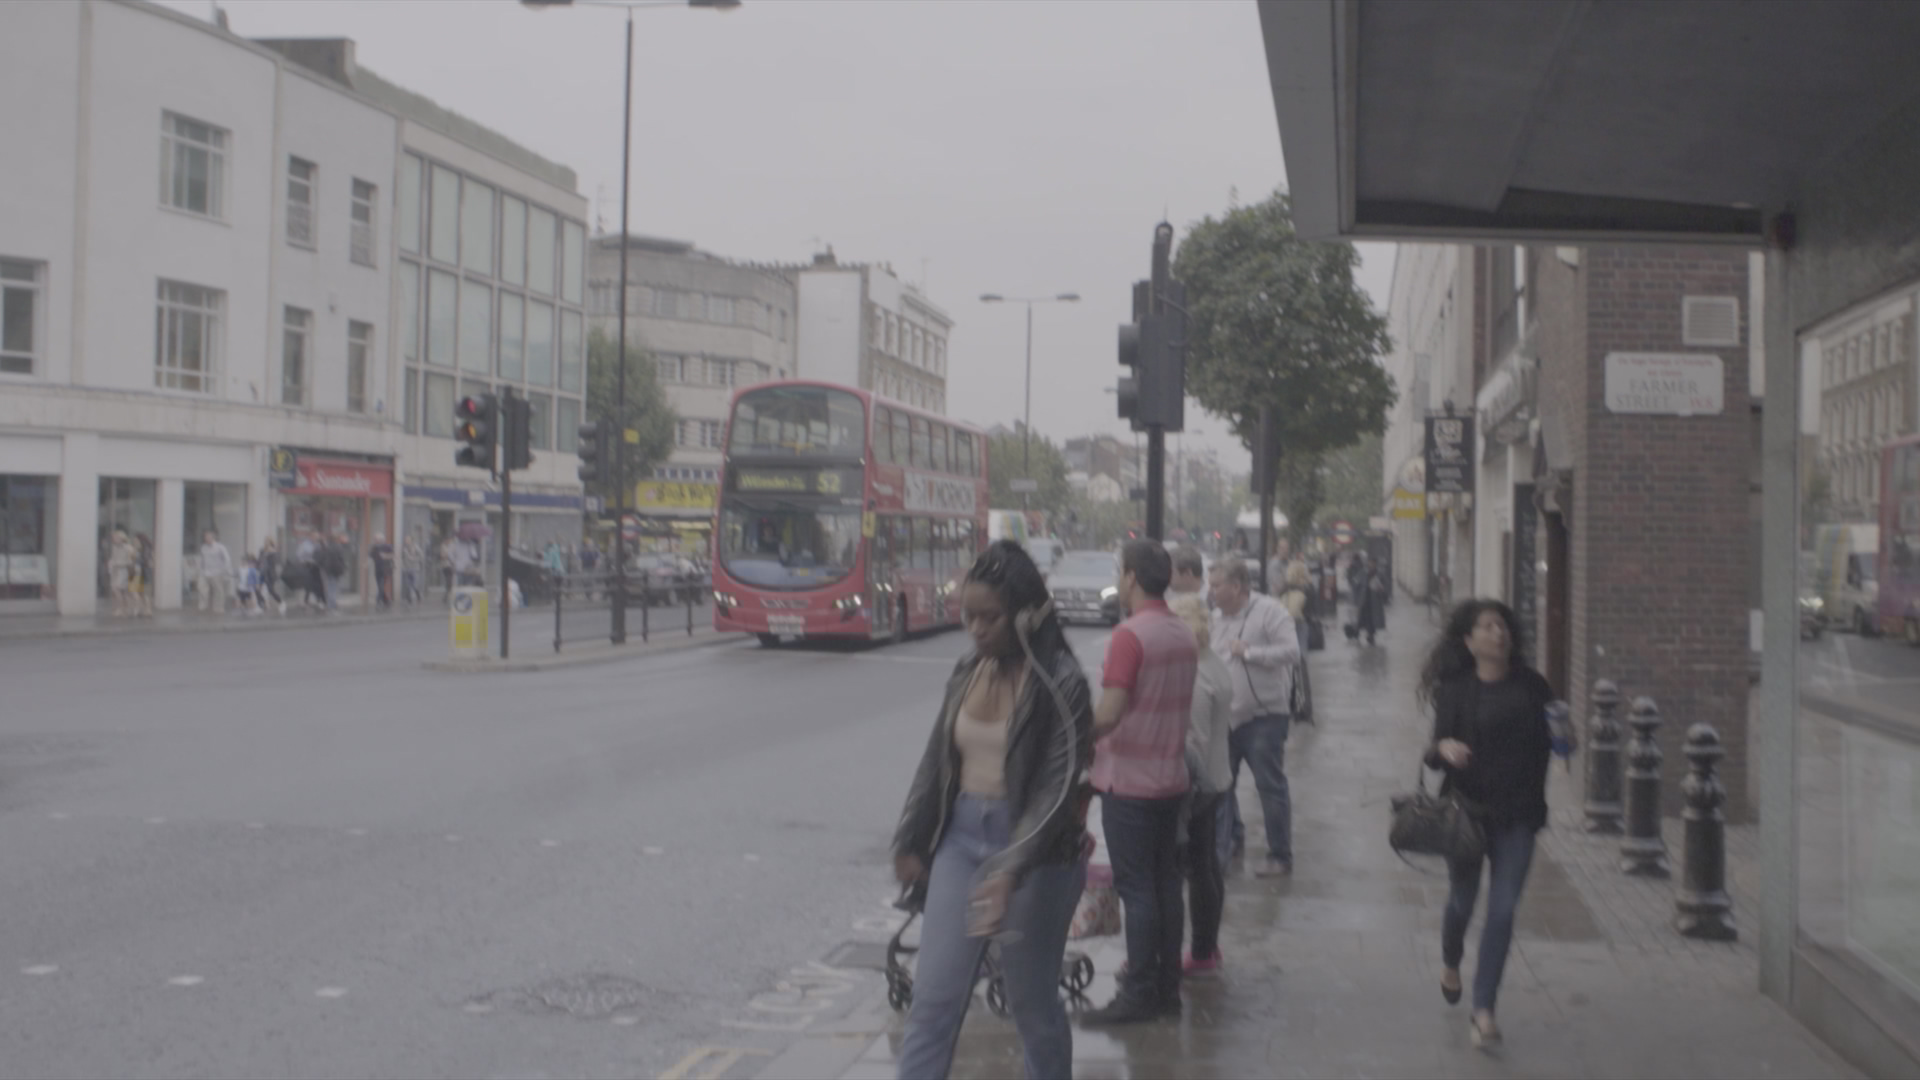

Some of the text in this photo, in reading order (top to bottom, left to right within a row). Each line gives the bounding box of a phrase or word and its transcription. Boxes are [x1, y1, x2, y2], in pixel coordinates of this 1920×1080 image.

[1630, 378, 1698, 394] FARMER
[1616, 394, 1671, 409] STREET
[312, 469, 371, 491] Santander
